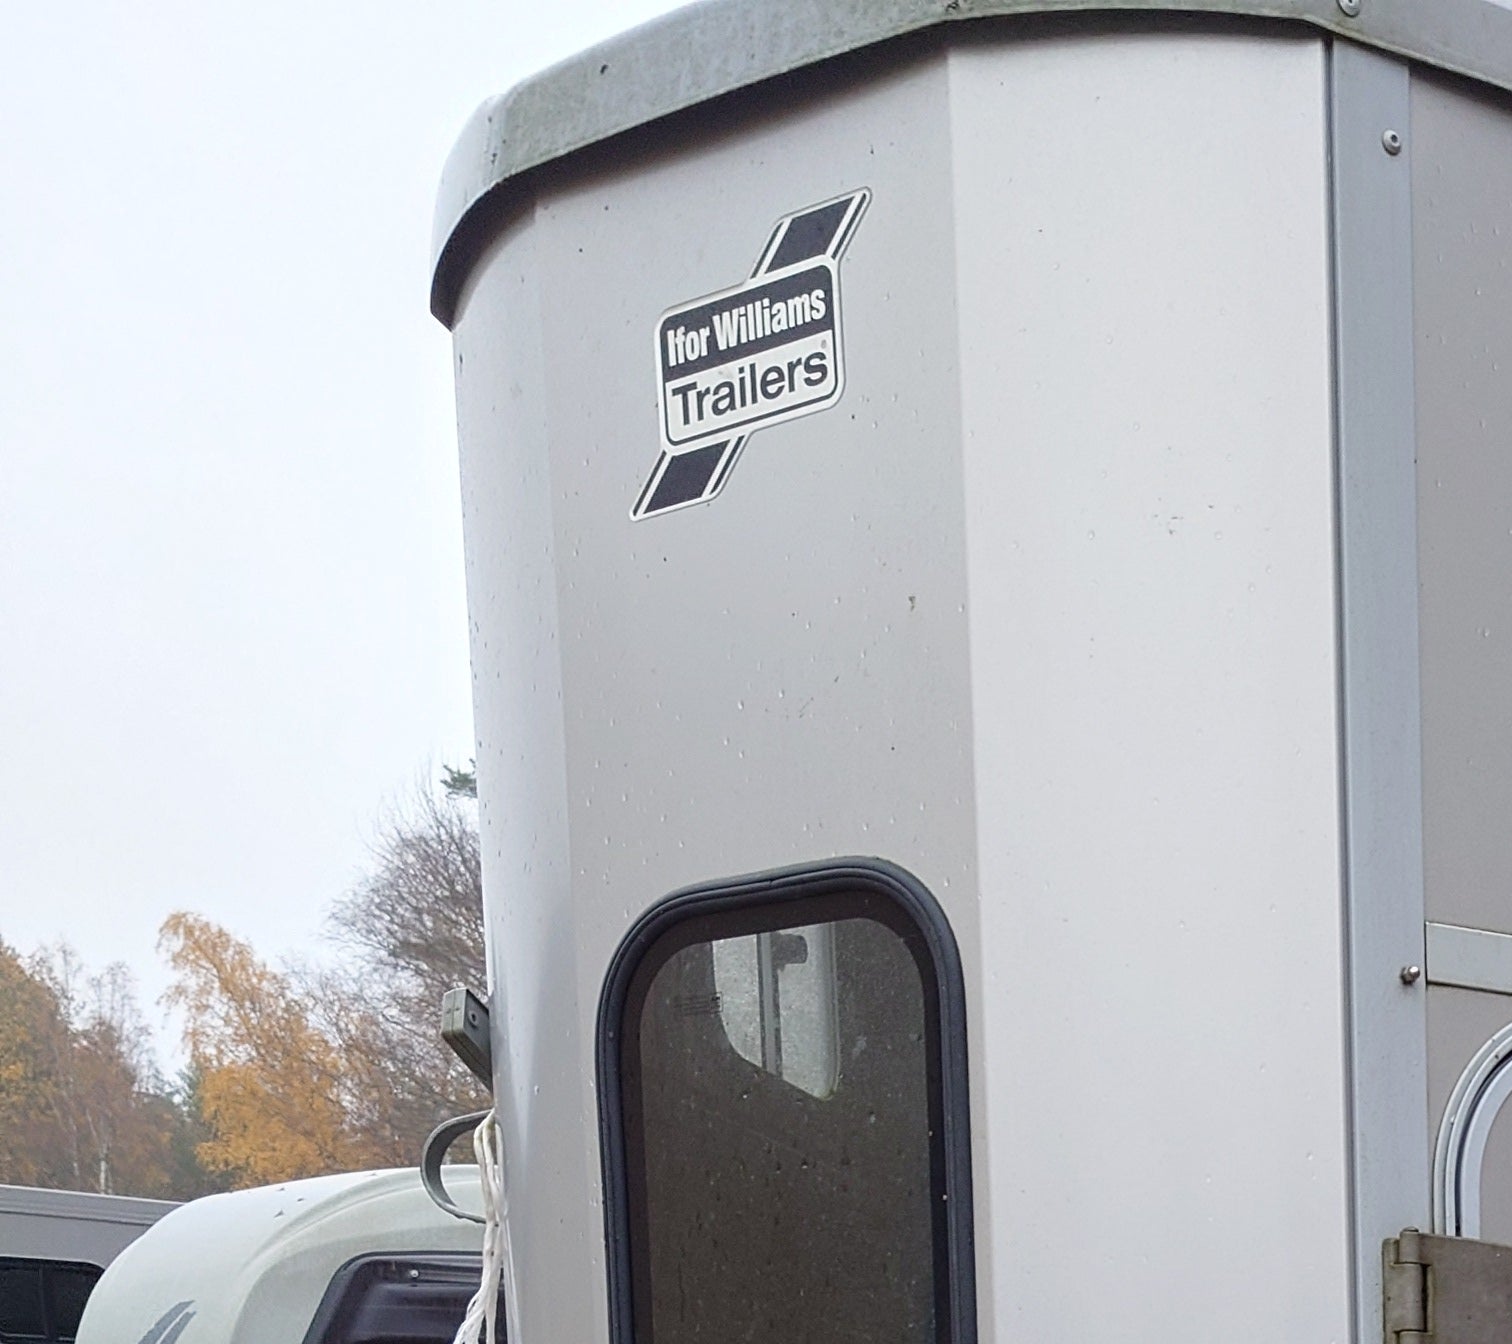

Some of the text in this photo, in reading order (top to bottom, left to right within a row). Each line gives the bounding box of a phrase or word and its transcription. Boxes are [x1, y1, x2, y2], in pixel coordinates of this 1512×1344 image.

[666, 288, 826, 367] Ifor Williams
[671, 350, 828, 426] Trailers
